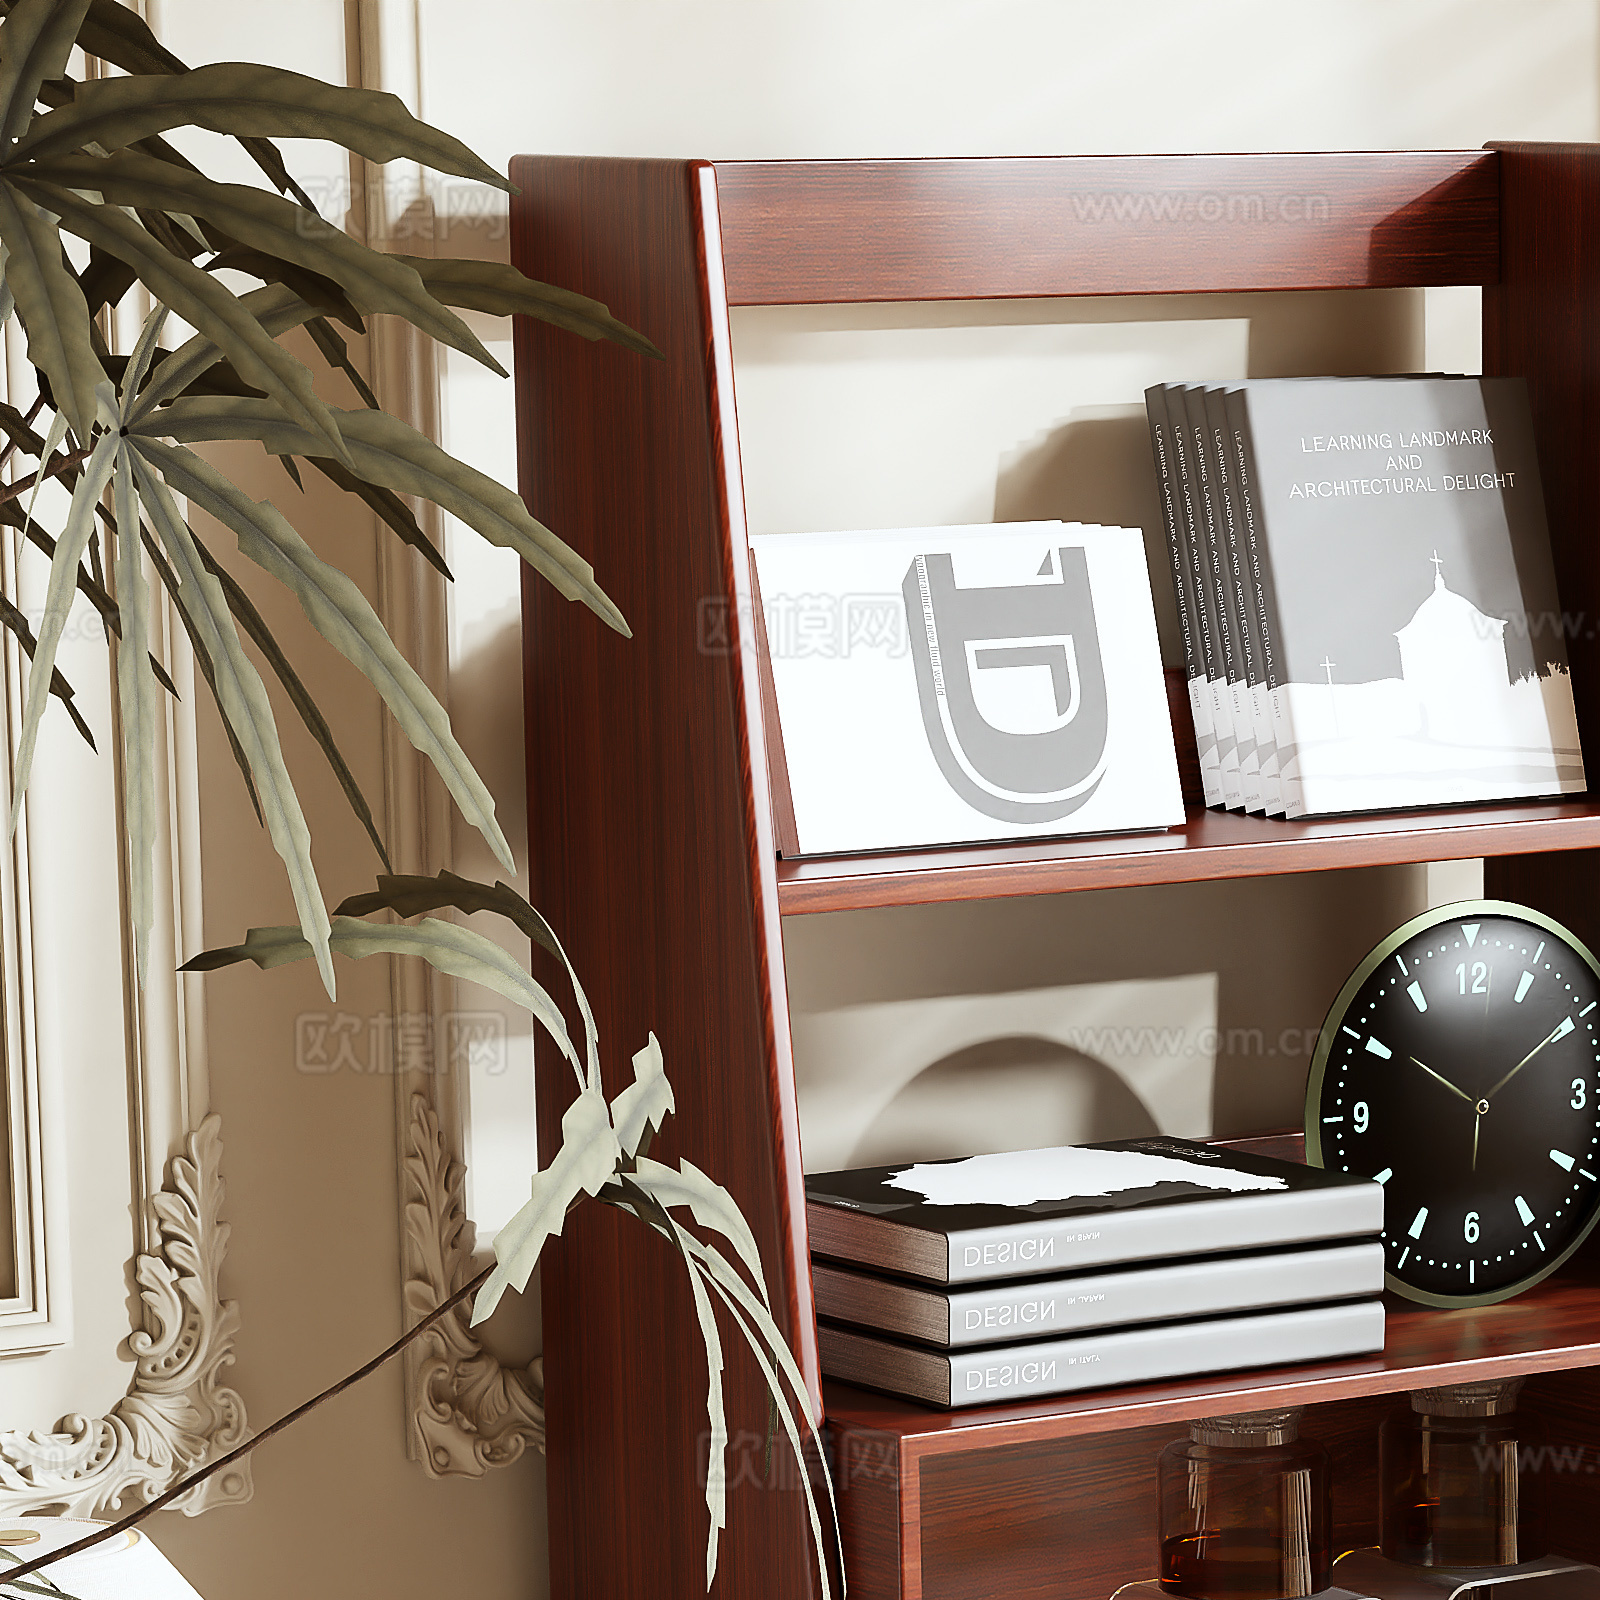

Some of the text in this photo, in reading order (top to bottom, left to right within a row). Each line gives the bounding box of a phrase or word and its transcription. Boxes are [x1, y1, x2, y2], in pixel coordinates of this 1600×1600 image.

[1175, 425, 1188, 480] LEARNING
[1301, 429, 1494, 453] LEARNING LANDMARK
[1386, 454, 1422, 471] AND
[1289, 472, 1515, 499] ARCHITECTURAL DELIGHT
[1183, 483, 1197, 544] LANDMARK
[1155, 424, 1168, 479] LEARNING
[1163, 482, 1177, 542] LANDMARK
[1172, 546, 1180, 570] AND
[1176, 574, 1193, 661] ARCHITECTURAL
[1194, 427, 1208, 482] LEARNING
[1203, 485, 1216, 546] LANDMARK
[1212, 550, 1220, 574] AND
[1216, 578, 1233, 666] ARCHITECTURAL
[1214, 428, 1228, 484] LEARNING
[1223, 487, 1237, 548] LANDMARK
[1232, 552, 1240, 576] AND
[1236, 580, 1253, 668] ARCHITECTURAL
[1234, 430, 1248, 486] LEARNING
[1243, 489, 1257, 550] LANDMARK
[1252, 554, 1260, 578] AND
[1256, 582, 1273, 671] ARCHITECTURAL
[1192, 548, 1200, 572] AND
[1195, 576, 1213, 664] ARCHITECTURAL
[1455, 961, 1487, 995] 12
[1570, 1077, 1586, 1110] 3
[1353, 1101, 1370, 1133] 9
[1463, 1211, 1480, 1244] 6
